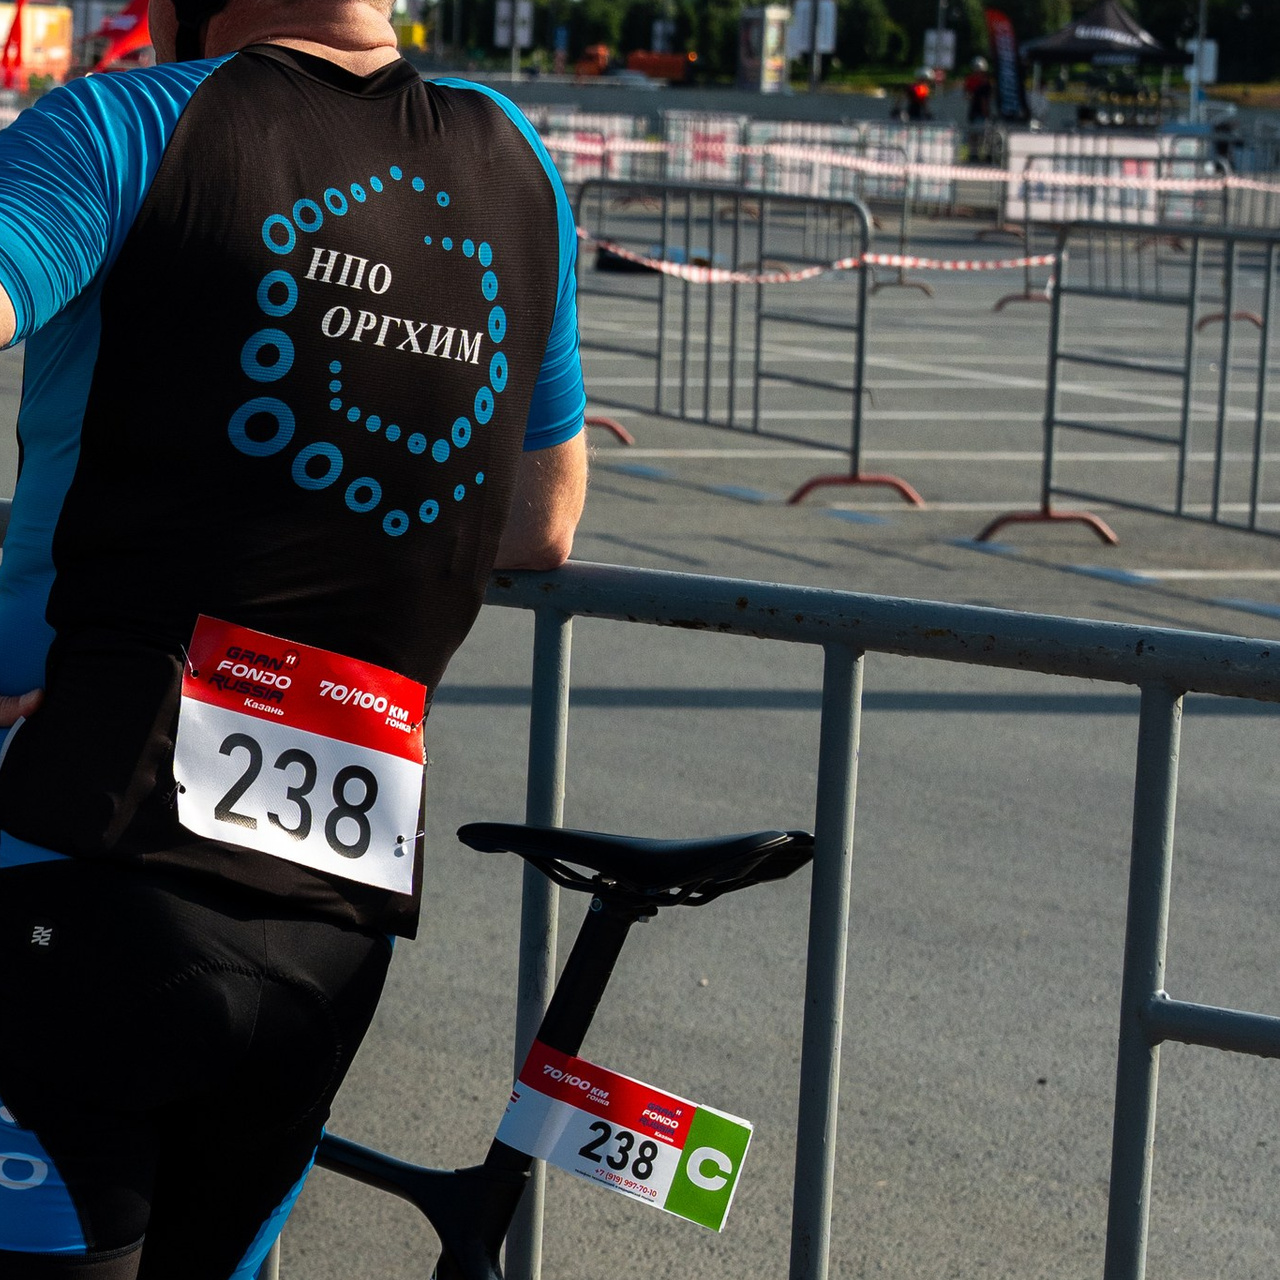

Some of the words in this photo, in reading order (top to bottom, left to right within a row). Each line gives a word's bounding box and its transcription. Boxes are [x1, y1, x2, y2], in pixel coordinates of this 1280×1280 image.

[303, 247, 393, 295] НПО
[320, 305, 484, 365] ОРГХИМ
[226, 646, 284, 671] GRAN
[286, 654, 297, 665] 11
[208, 673, 284, 704] RUSSIA
[216, 660, 292, 690] FONDO
[243, 697, 284, 716] Казань
[319, 680, 388, 713] 70/100
[384, 718, 411, 734] гонка
[214, 732, 379, 859] 238
[543, 1064, 591, 1091] 70/100
[585, 1094, 610, 1107] гонка
[642, 1109, 679, 1129] FONDO
[578, 1121, 659, 1181] 238
